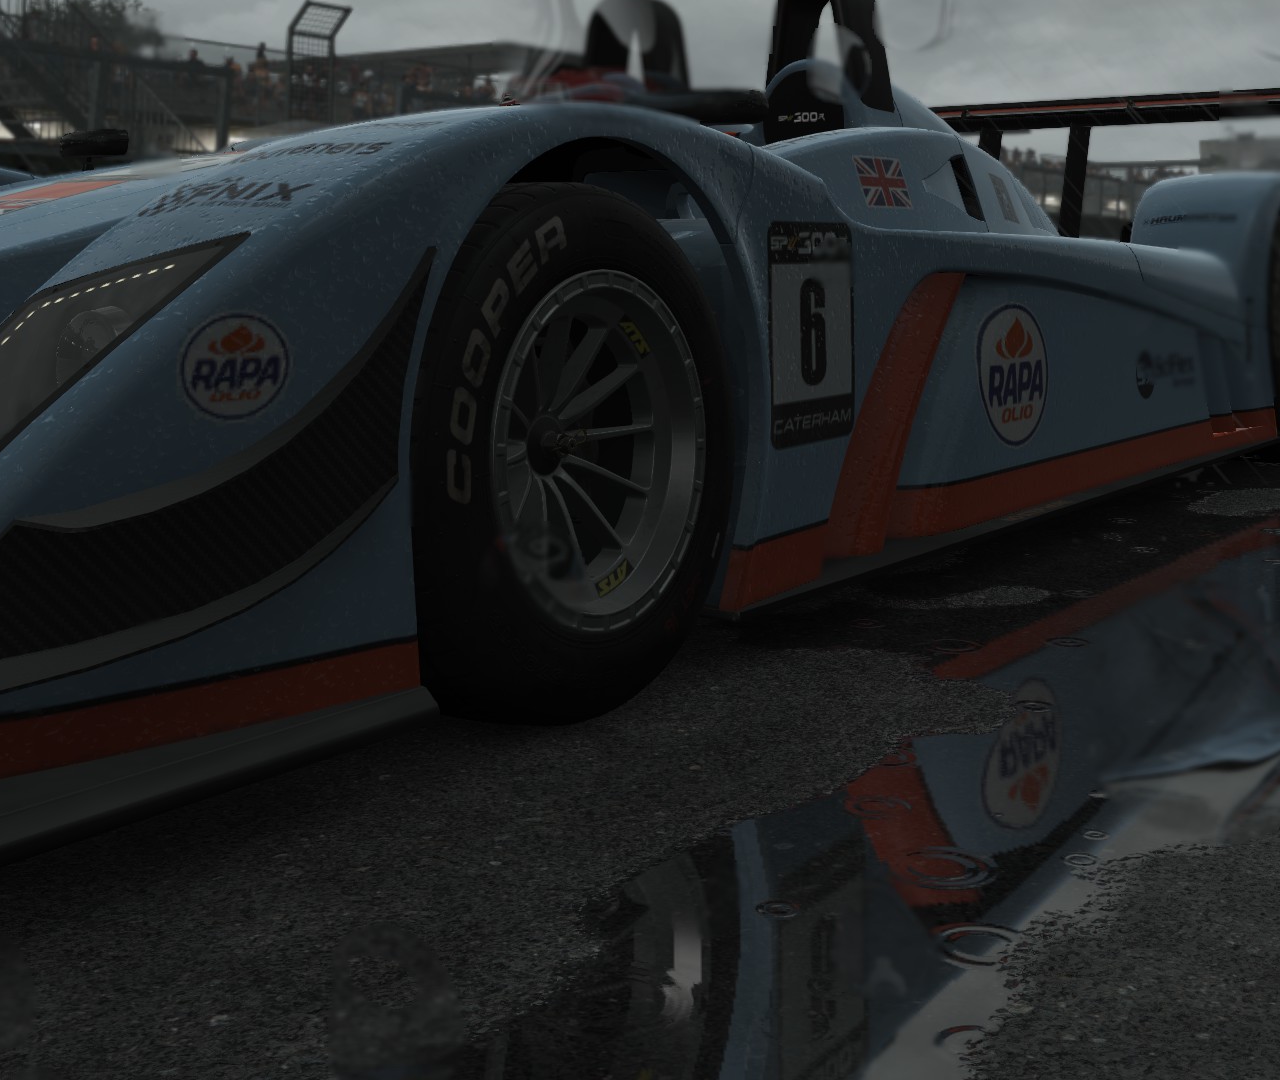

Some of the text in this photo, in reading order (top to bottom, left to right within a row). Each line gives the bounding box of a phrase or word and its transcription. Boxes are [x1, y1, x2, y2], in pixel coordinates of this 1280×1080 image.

[618, 321, 651, 355] ATS
[800, 277, 827, 386] 6
[192, 355, 280, 392] RAPA
[446, 216, 568, 505] COOPER
[988, 359, 1044, 408] RAPA
[773, 407, 852, 435] CATERHAM
[1001, 404, 1034, 424] OLIO
[597, 559, 628, 599] ATS
